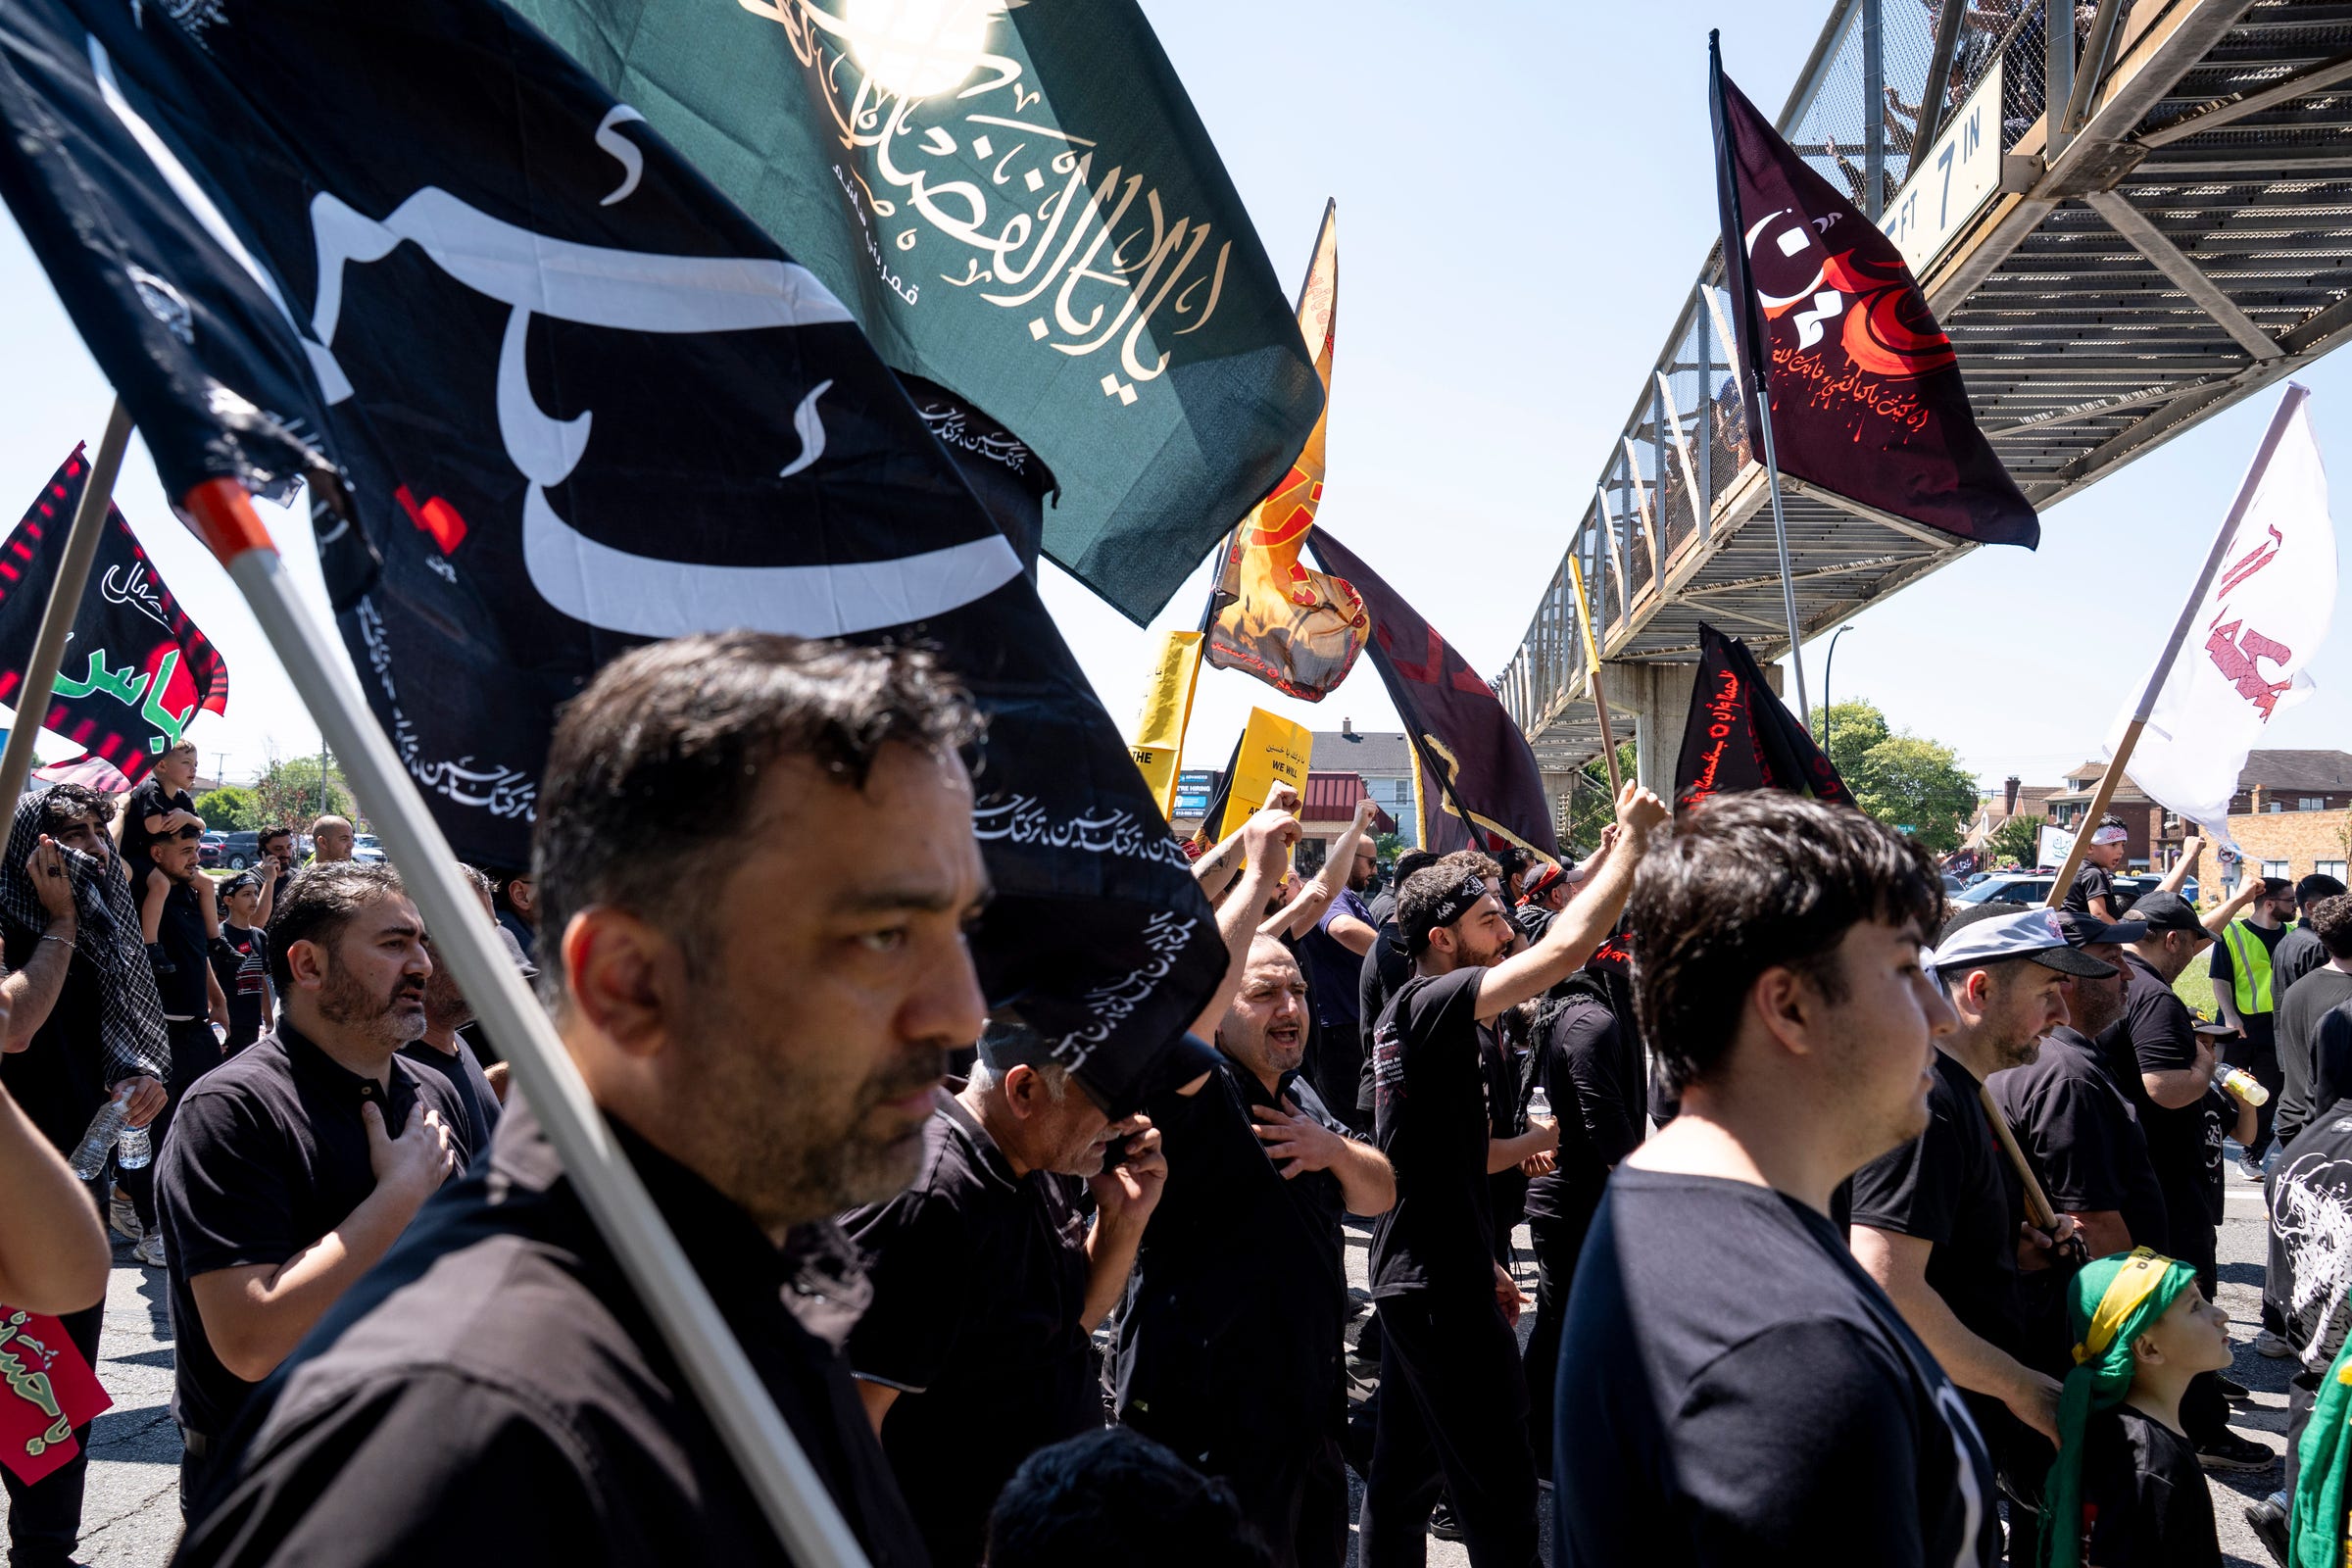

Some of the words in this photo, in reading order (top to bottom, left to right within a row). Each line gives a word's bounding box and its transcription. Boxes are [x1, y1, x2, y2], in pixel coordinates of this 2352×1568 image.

[1900, 188, 1918, 243] FT
[1937, 140, 1956, 231] 7
[1964, 105, 1981, 165] IN
[881, 265, 919, 306] قمر
[1272, 760, 1285, 772] WE
[1286, 765, 1298, 778] WILL
